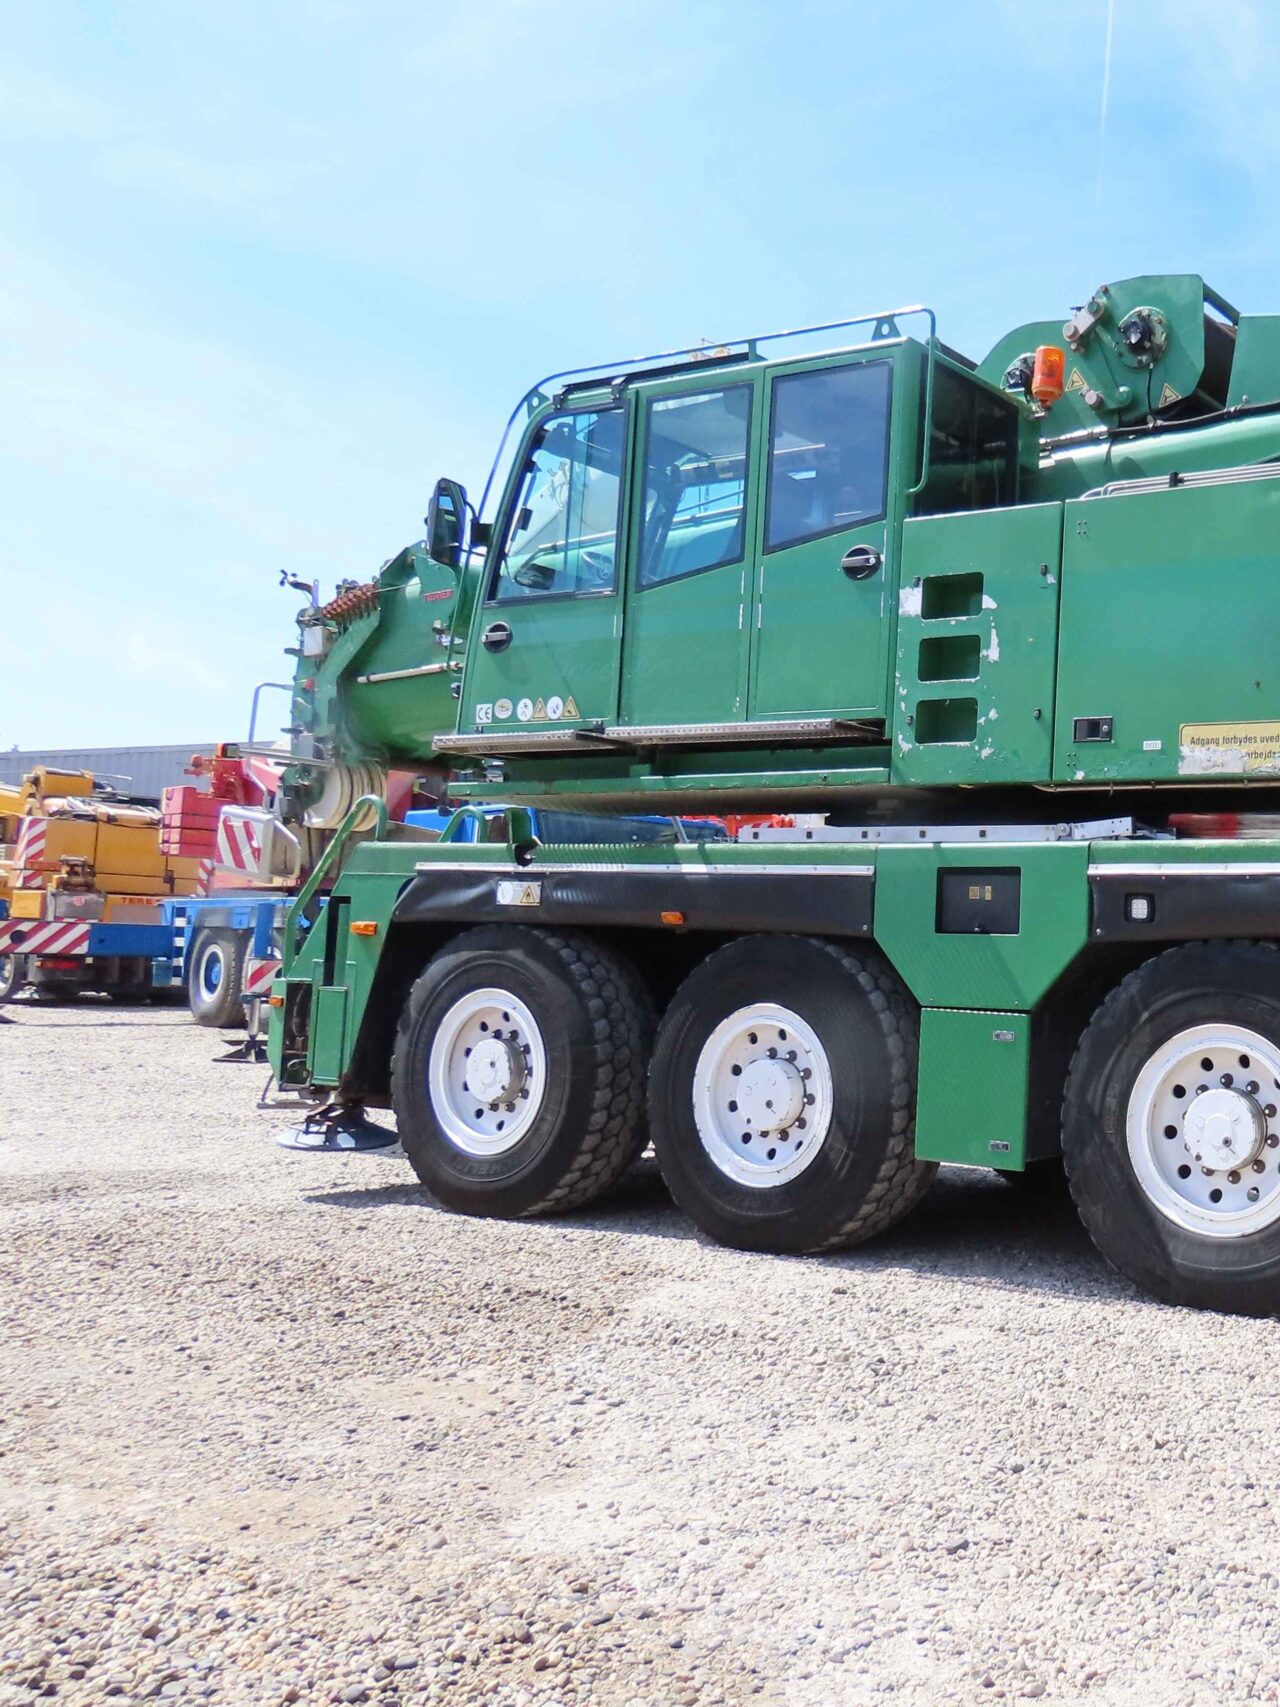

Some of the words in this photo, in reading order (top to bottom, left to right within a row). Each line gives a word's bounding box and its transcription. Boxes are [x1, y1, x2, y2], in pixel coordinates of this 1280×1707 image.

[478, 706, 491, 720] CE
[1190, 735, 1220, 747] Adgang
[1222, 734, 1258, 748] forbydes
